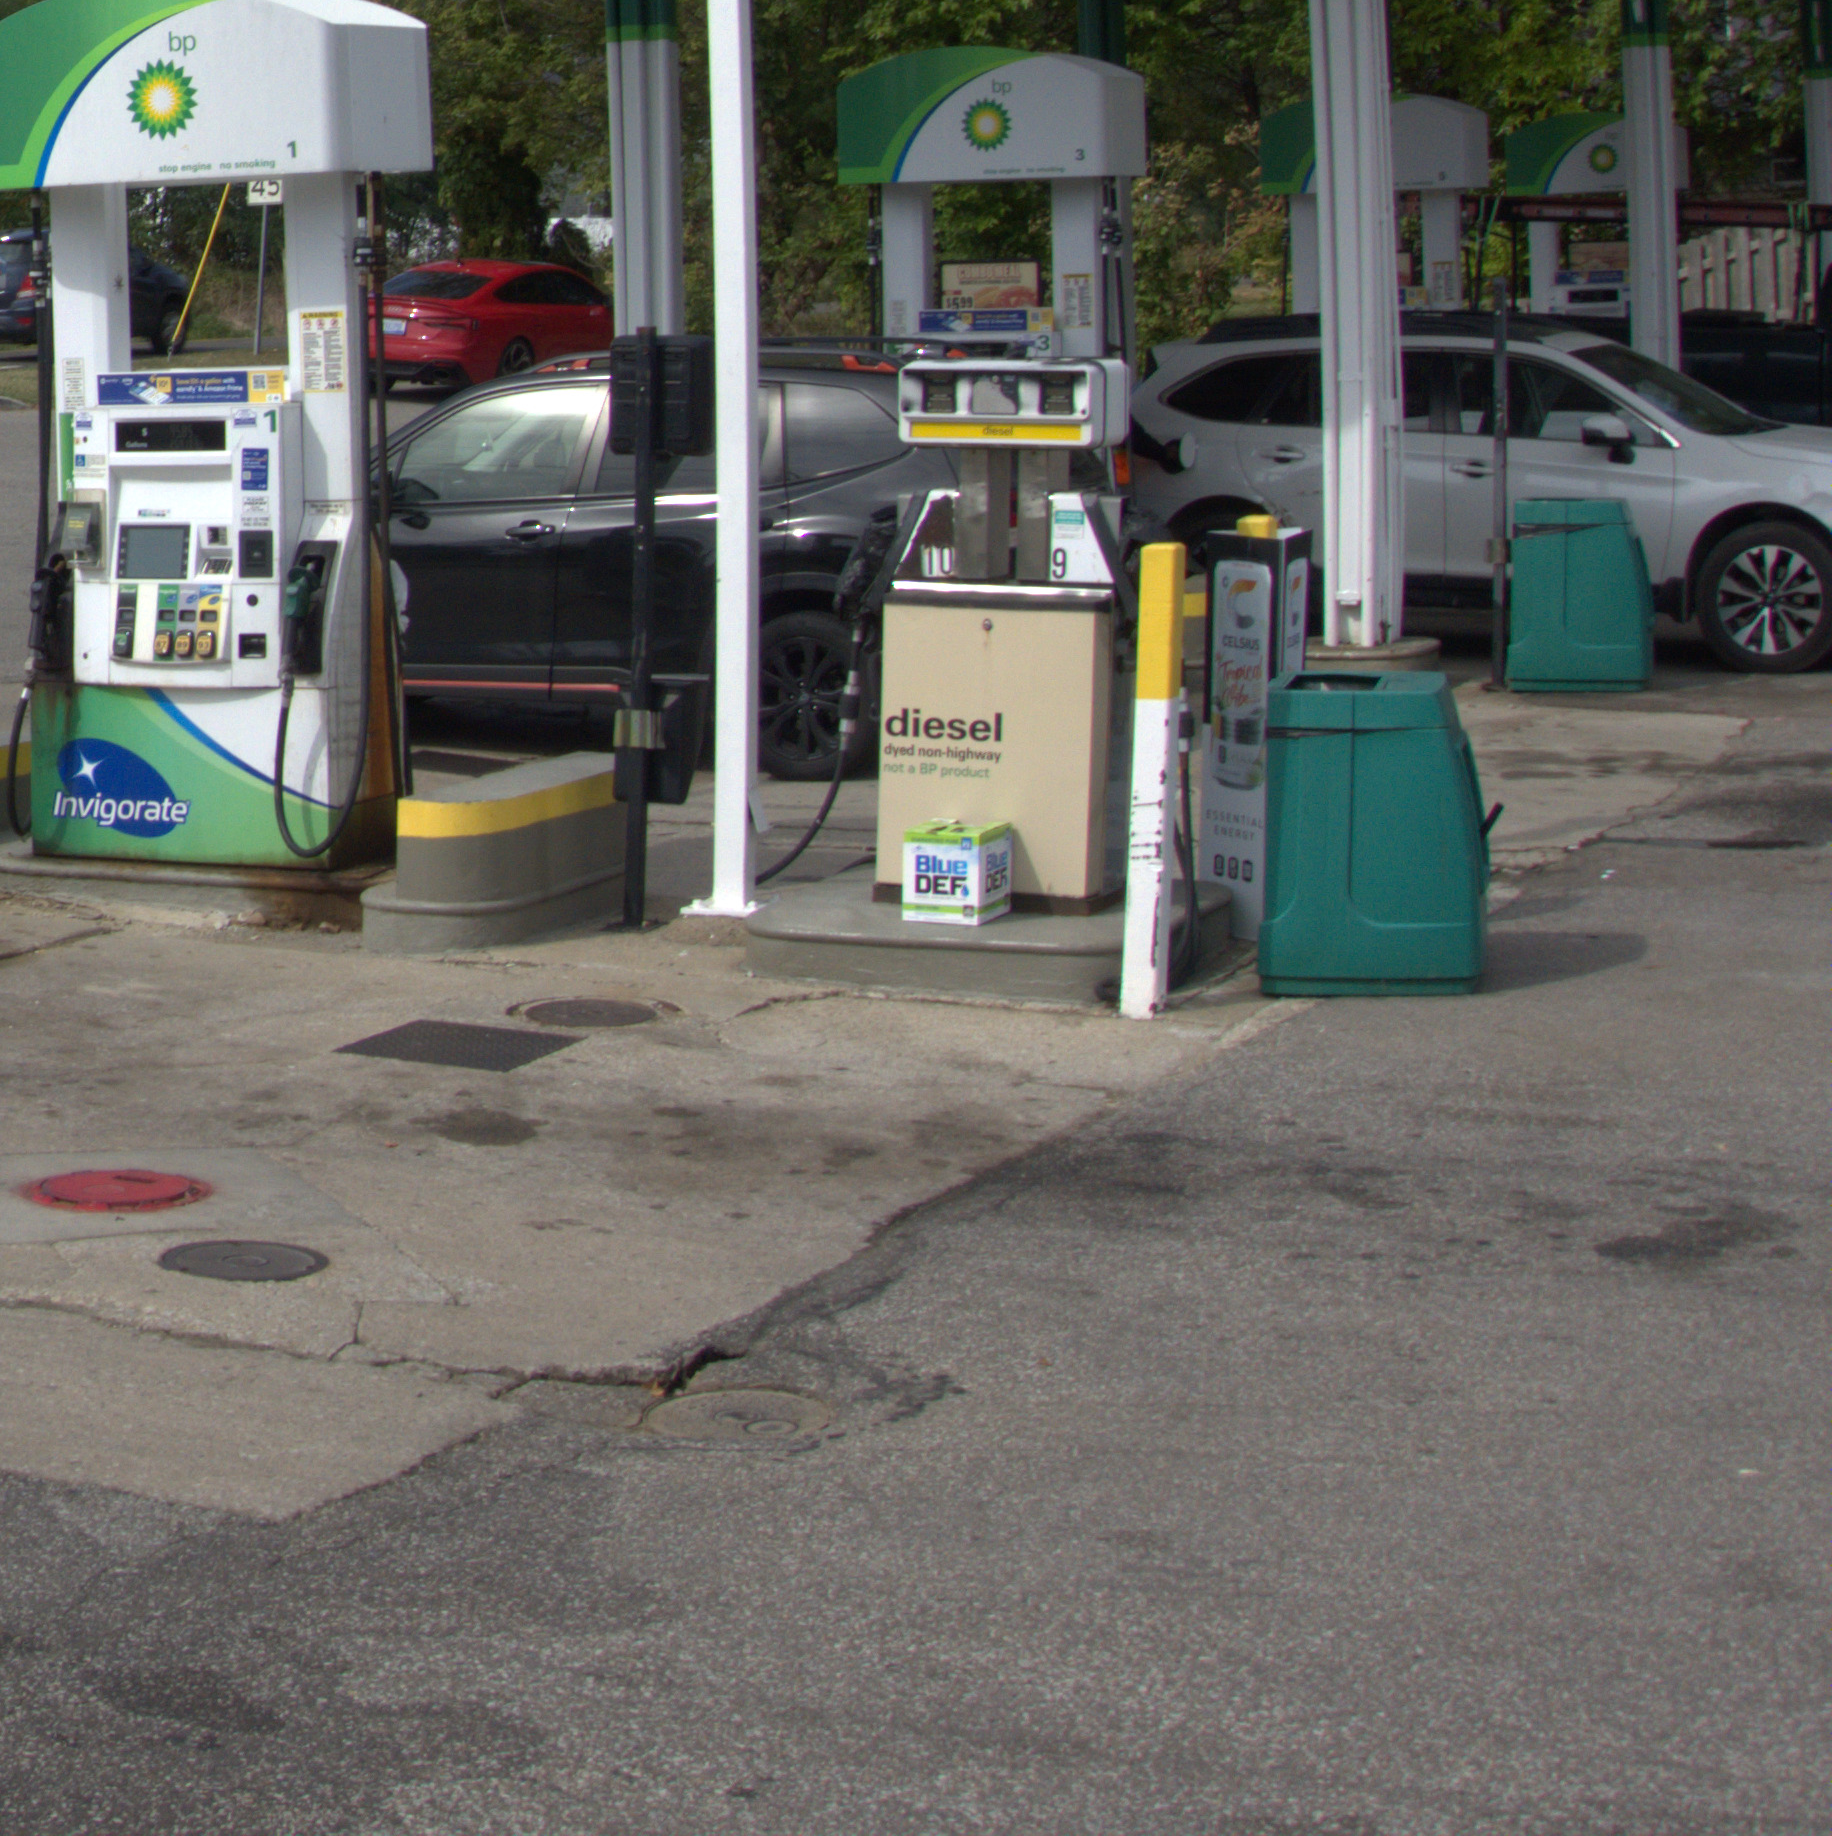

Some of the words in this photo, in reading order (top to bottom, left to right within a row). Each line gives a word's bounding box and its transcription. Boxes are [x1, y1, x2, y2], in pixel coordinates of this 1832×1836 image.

[168, 30, 197, 57] bp
[991, 77, 1013, 96] bp
[286, 140, 298, 159] 1
[1075, 148, 1086, 161] 3
[158, 163, 179, 174] stop
[180, 161, 213, 172] engine
[219, 161, 232, 170] no
[234, 158, 277, 169] smoking
[250, 179, 281, 197] 45
[1038, 334, 1050, 352] 3
[263, 409, 277, 433] 1
[982, 426, 1014, 437] diesel
[1051, 547, 1068, 580] 9
[1222, 634, 1260, 651] CELSIUS
[884, 707, 1003, 743] diesel
[884, 743, 915, 759] dyed
[918, 745, 1002, 764] non-highway
[884, 763, 904, 774] not
[907, 764, 916, 774] a
[919, 763, 937, 775] BP
[940, 765, 990, 779] product
[53, 791, 188, 826] Invigorate
[1206, 809, 1263, 829] ESSENTIAL
[1213, 824, 1255, 842] ENERGY
[915, 854, 968, 876] Blue
[914, 873, 968, 896] DEF
